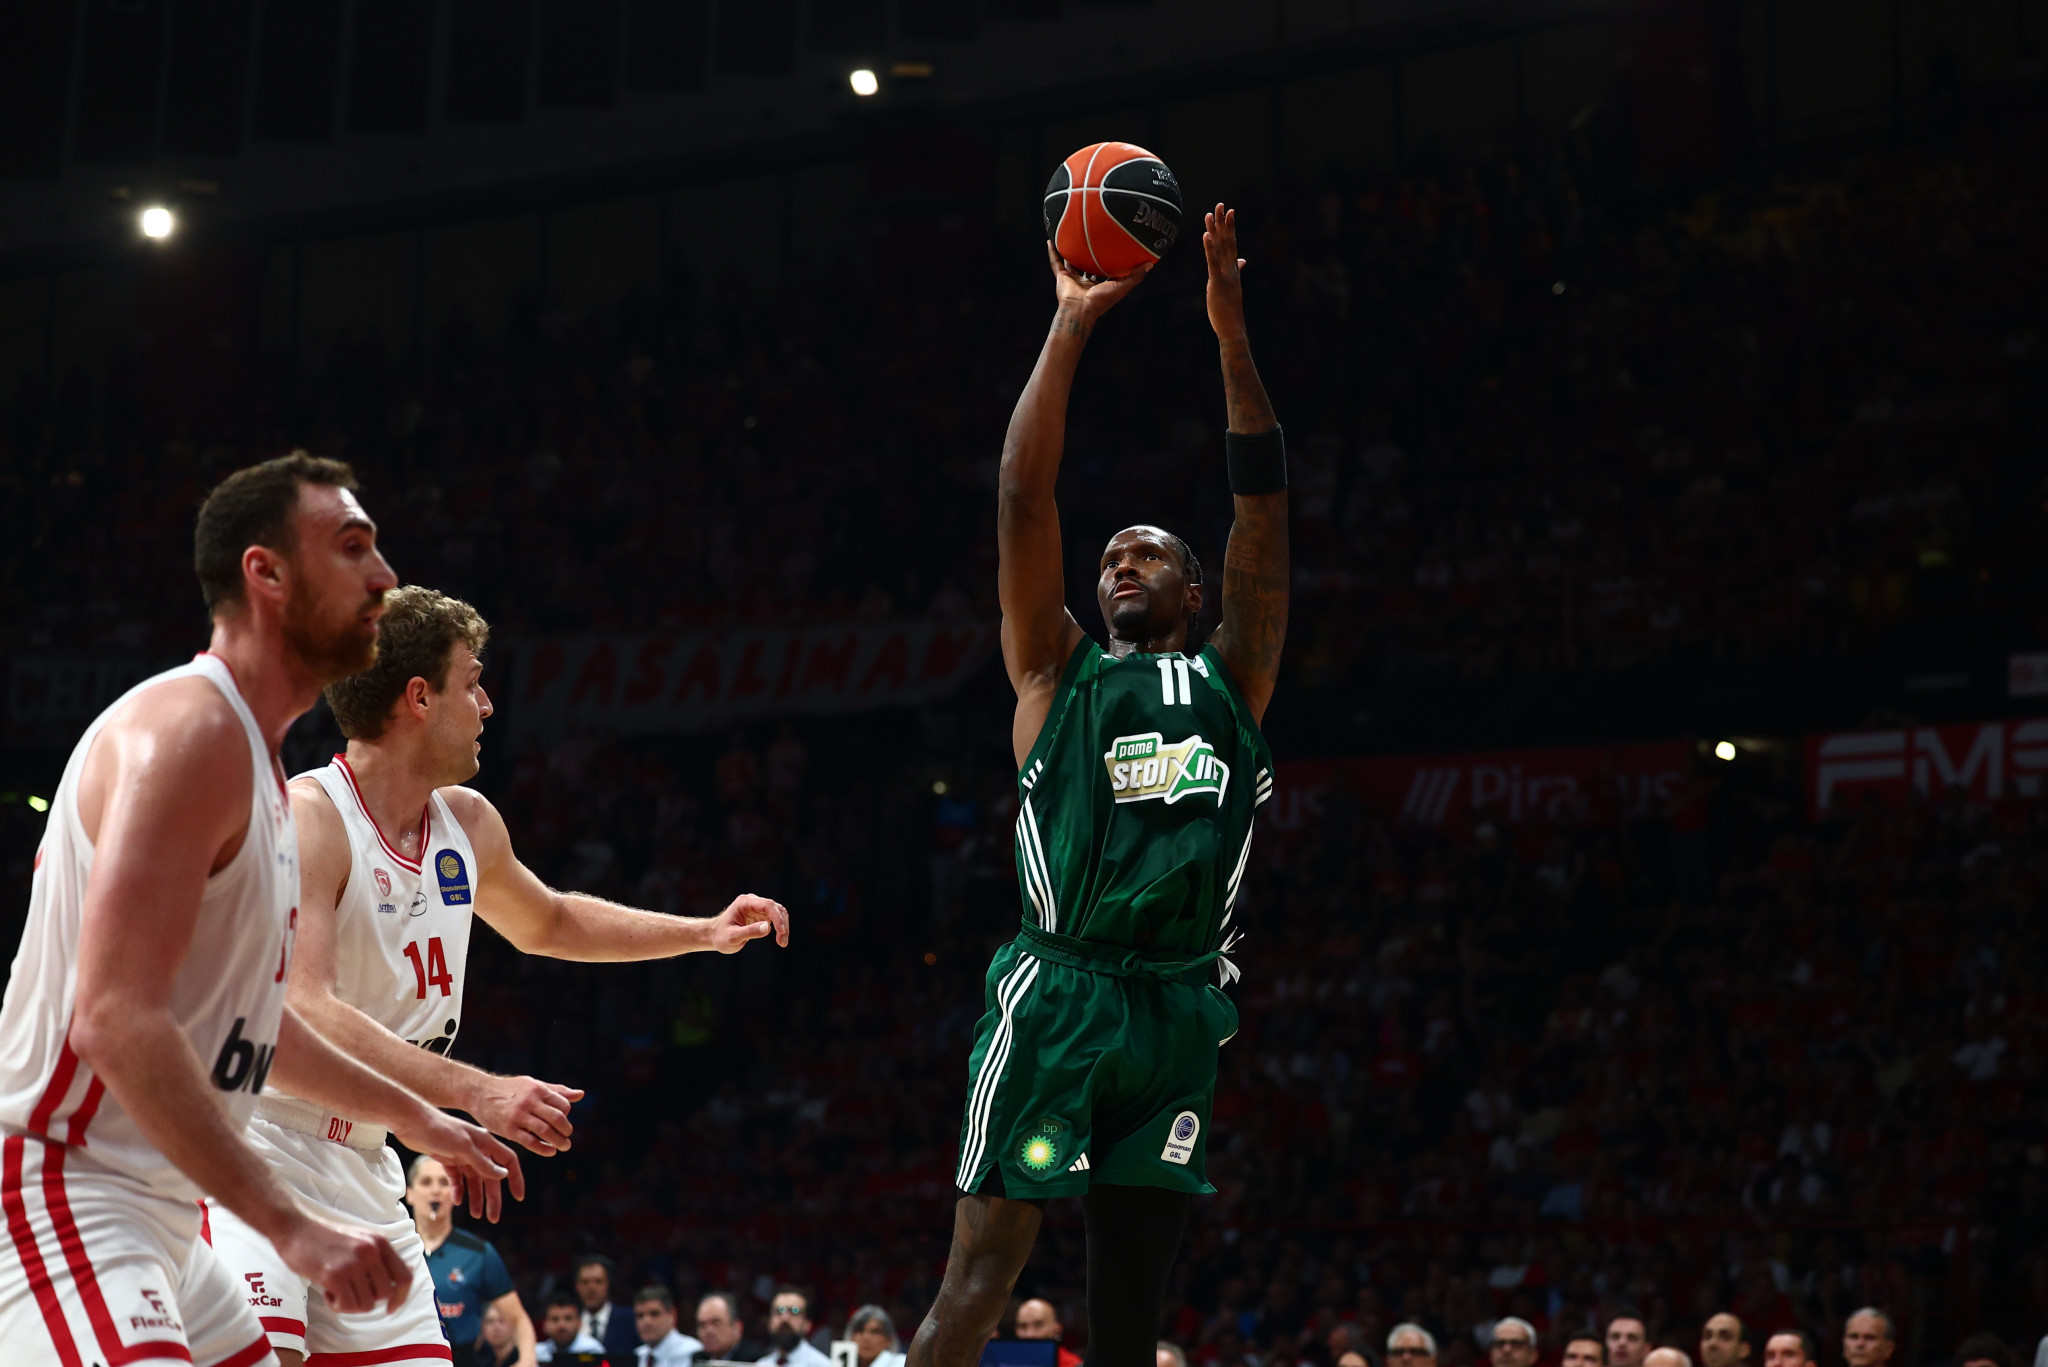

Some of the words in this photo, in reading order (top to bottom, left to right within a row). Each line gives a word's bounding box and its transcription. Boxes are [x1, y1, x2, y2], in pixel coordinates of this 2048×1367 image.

[1157, 658, 1192, 706] 11
[1118, 741, 1153, 759] pame
[449, 894, 465, 902] GBL
[403, 936, 453, 1000] 14
[1043, 1123, 1057, 1135] bp
[130, 1315, 182, 1332] FlexCa
